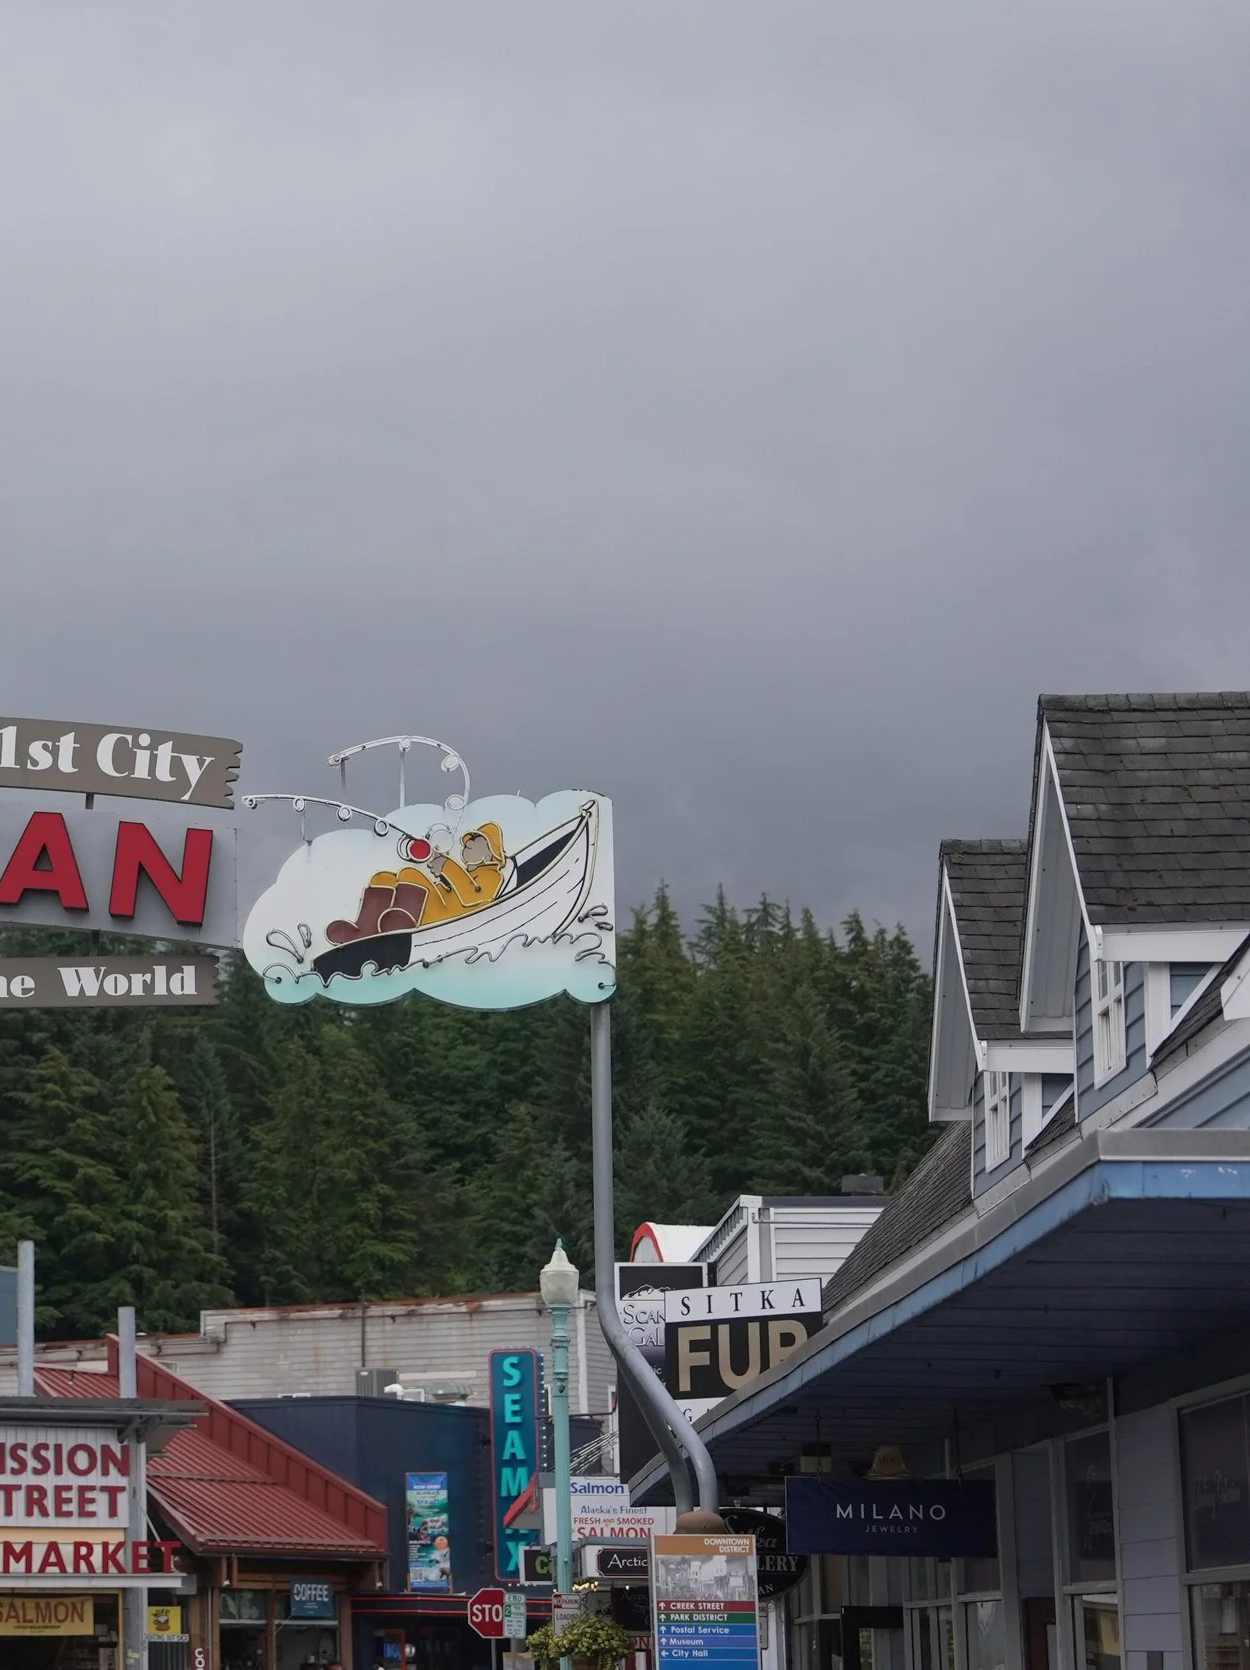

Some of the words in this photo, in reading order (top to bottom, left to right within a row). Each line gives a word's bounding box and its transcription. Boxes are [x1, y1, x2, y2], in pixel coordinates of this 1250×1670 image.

[96, 733, 215, 801] City
[58, 965, 198, 997] World
[680, 1287, 806, 1317] SITKA
[499, 1356, 530, 1573] SEAMX
[570, 1482, 624, 1494] Salmon
[580, 1506, 618, 1515] Alaska's
[836, 1503, 946, 1520] MILANO
[573, 1517, 601, 1525] FRESH
[616, 1517, 655, 1525] SMOKED
[577, 1527, 651, 1539] SALMON
[704, 1538, 750, 1546] DOWNTOWN
[2, 1540, 181, 1574] MARKET
[607, 1553, 648, 1569] Arctic
[293, 1583, 330, 1602] COFFEE
[505, 1605, 511, 1617] 2
[670, 1602, 695, 1610] CREEK
[472, 1604, 503, 1623] STO
[670, 1626, 695, 1634] Postal
[698, 1626, 730, 1634] Service
[672, 1649, 690, 1658] City
[692, 1649, 708, 1657] Hall
